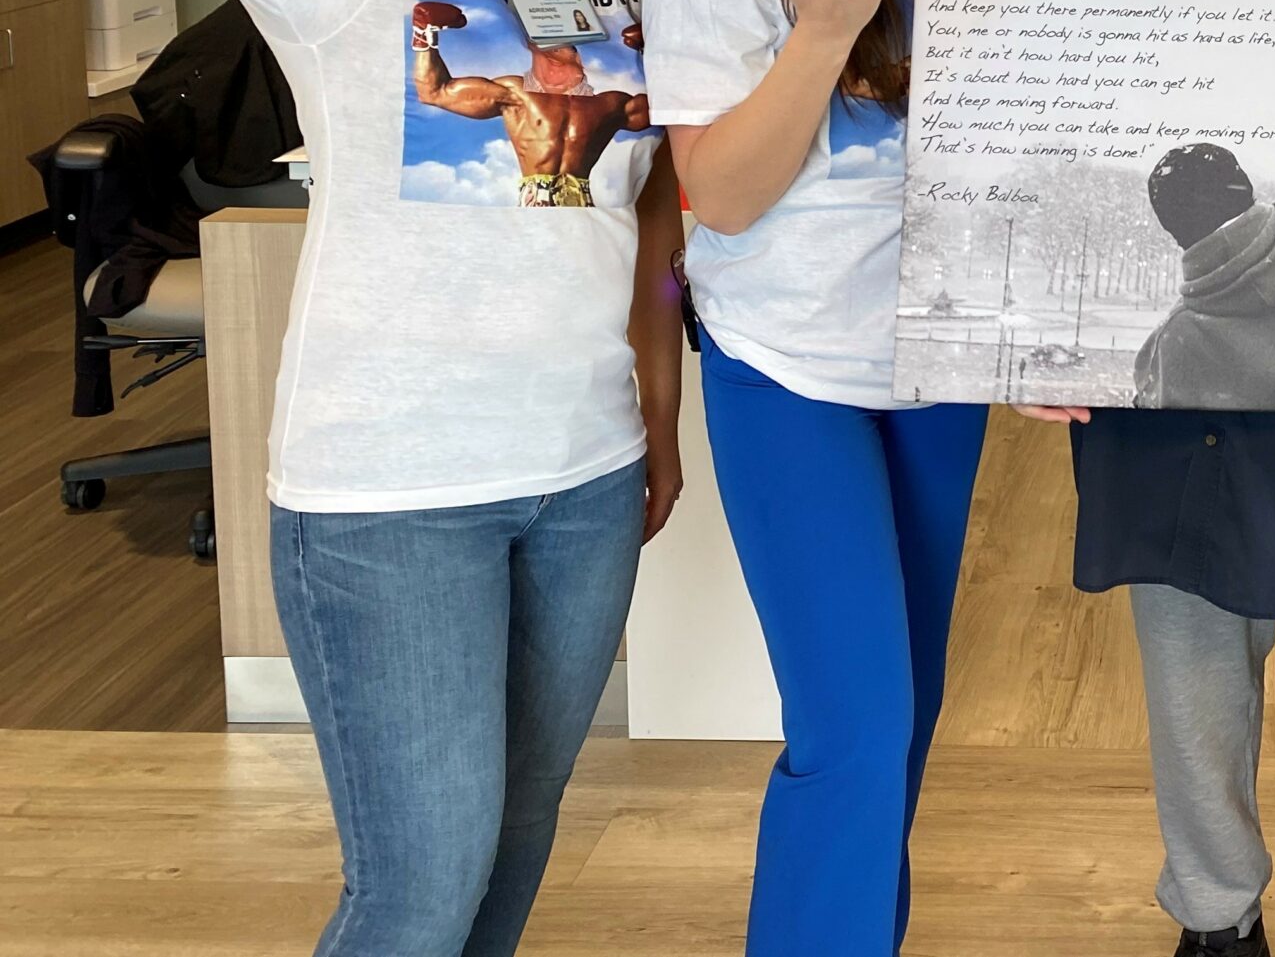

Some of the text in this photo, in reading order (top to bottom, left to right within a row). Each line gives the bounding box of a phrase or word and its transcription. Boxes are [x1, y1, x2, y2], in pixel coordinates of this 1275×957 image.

[1000, 5, 1030, 19] you
[1036, 2, 1077, 15] there
[1080, 5, 1173, 23] permanently
[1178, 6, 1195, 19] if
[1196, 11, 1226, 24] you
[1232, 8, 1254, 21] let
[1260, 9, 1275, 21] it.
[928, 20, 961, 38] You,
[967, 28, 988, 36] me
[1018, 24, 1073, 43] nobody
[1078, 27, 1092, 39] is
[1095, 32, 1141, 46] gonna
[1146, 28, 1169, 42] hit
[1171, 33, 1188, 42] as
[1193, 31, 1224, 43] hard
[1228, 35, 1245, 44] as
[1249, 32, 1275, 47] life,
[925, 44, 1159, 67] But it ain't how hard you hit,
[924, 66, 1214, 95] It's about how hard you can get hit
[923, 90, 1118, 114] And keep moving forward.
[922, 111, 963, 131] How
[968, 118, 1014, 131] much
[1019, 123, 1049, 136] you
[1055, 123, 1082, 133] can
[1088, 119, 1119, 136] take
[1126, 123, 1152, 135] and
[1156, 121, 1190, 140] keep
[1196, 125, 1245, 144] moving
[920, 134, 976, 153] That's
[981, 141, 1016, 155] how
[1022, 143, 1078, 163] winning
[1083, 147, 1098, 157] is
[986, 185, 1039, 204] Balboa
